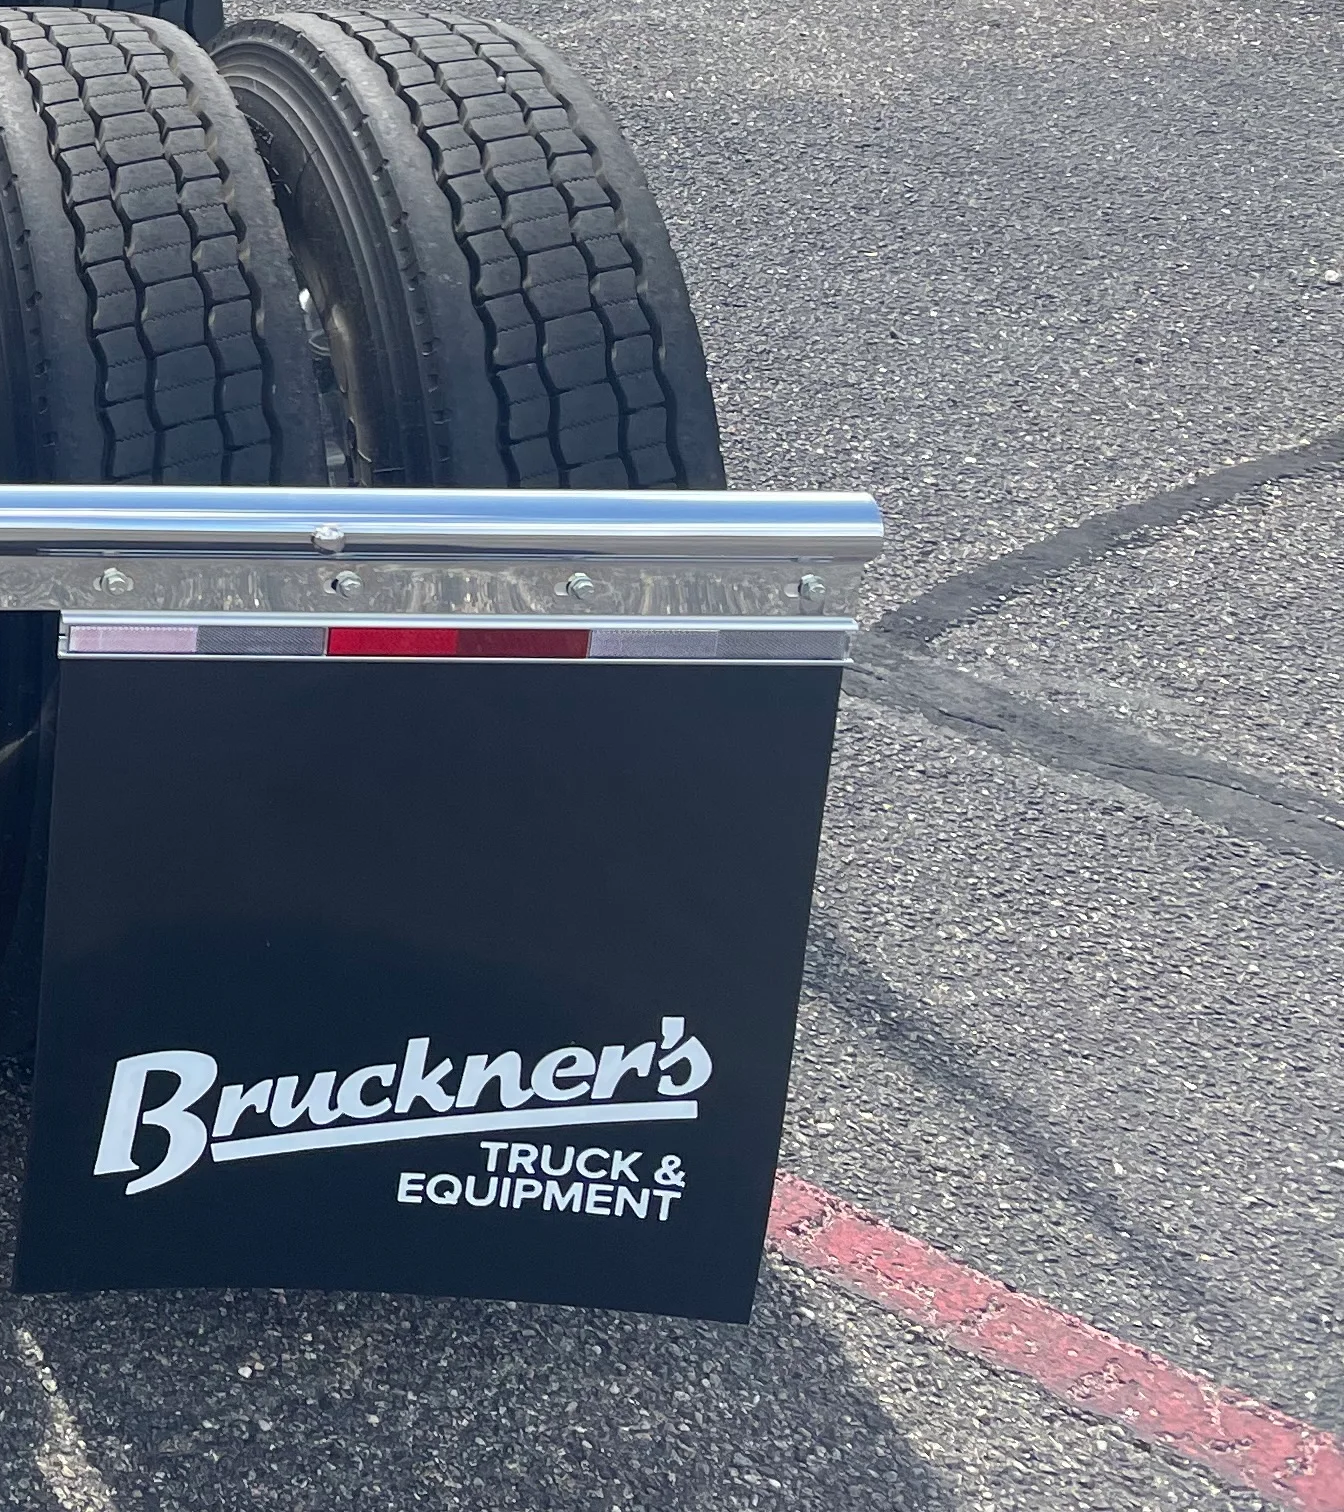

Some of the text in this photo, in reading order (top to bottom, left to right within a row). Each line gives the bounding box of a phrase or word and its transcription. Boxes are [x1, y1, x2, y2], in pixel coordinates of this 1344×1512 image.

[93, 1016, 713, 1196] Bruckner's
[480, 1140, 686, 1188] TRUCK &
[397, 1172, 682, 1221] EQUIPMENT
